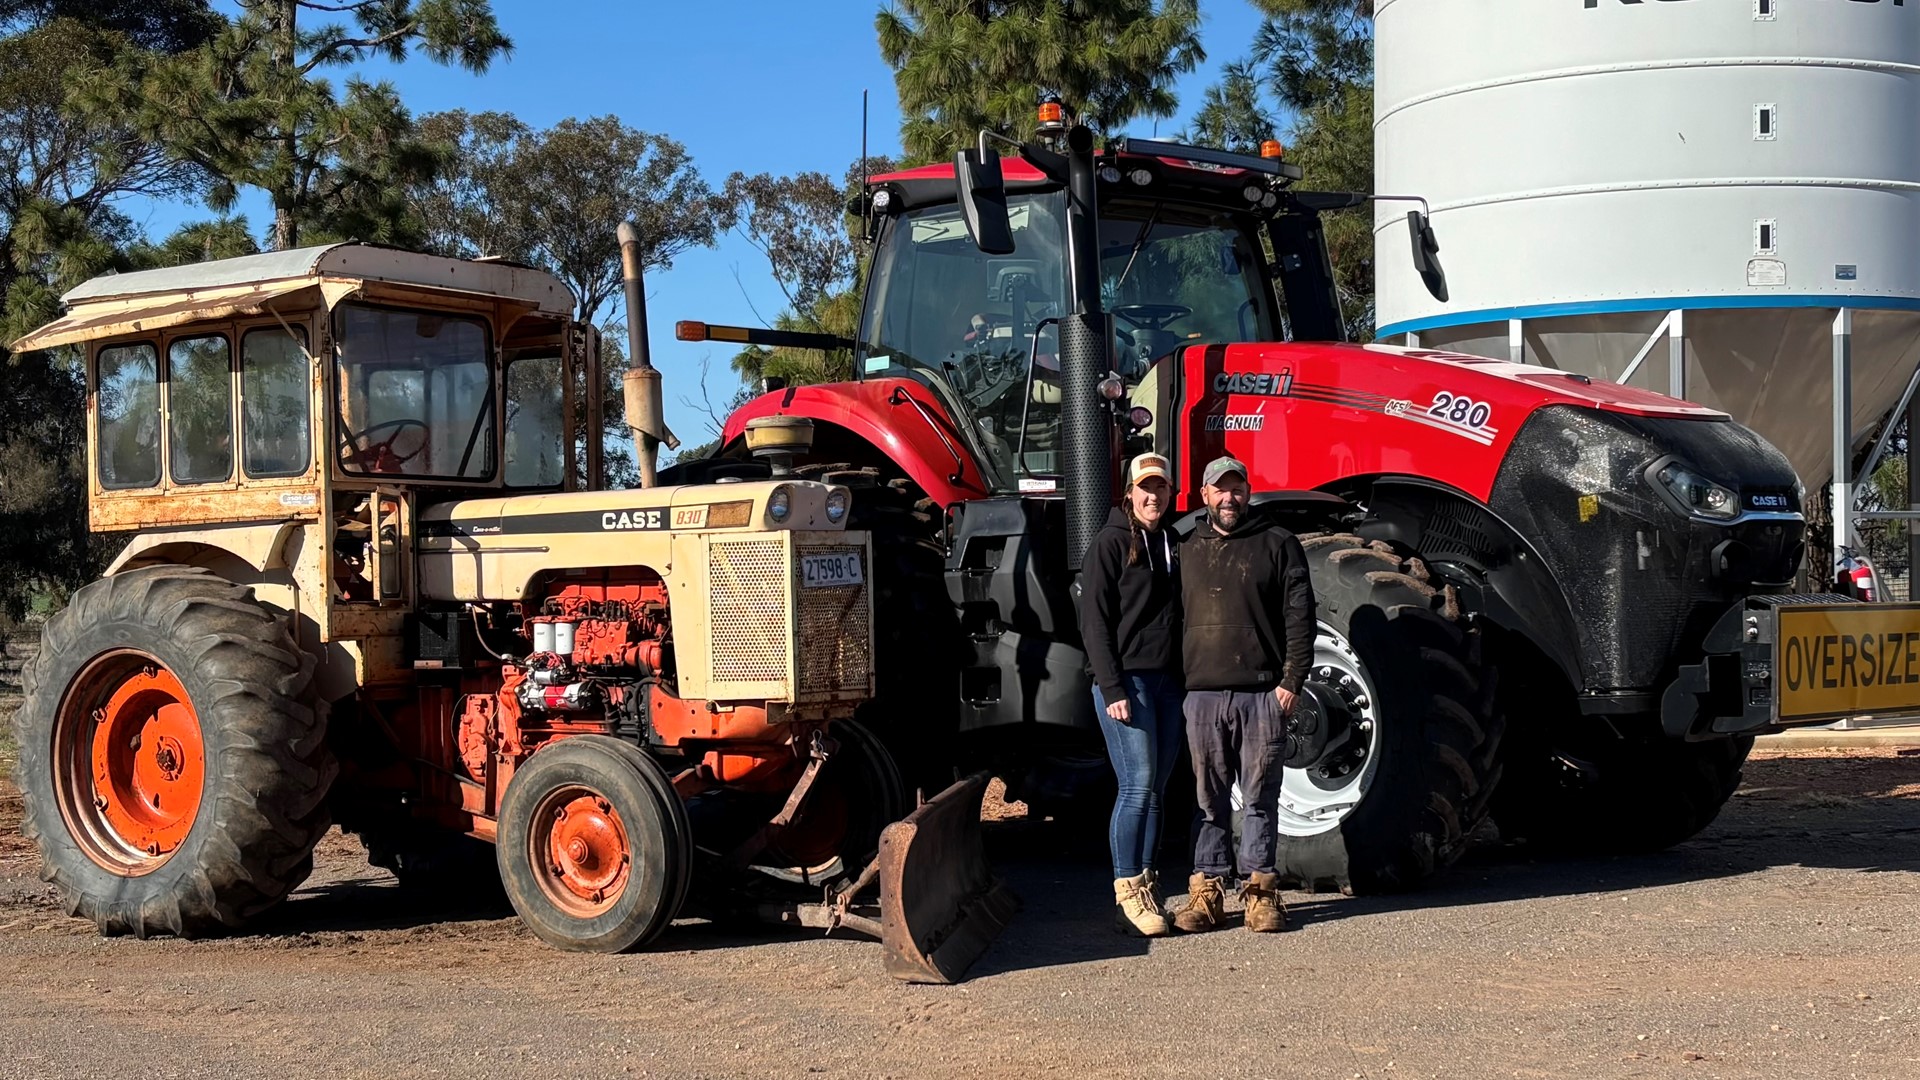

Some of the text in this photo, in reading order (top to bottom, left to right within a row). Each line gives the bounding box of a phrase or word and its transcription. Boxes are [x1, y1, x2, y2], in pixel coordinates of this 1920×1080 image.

[1213, 372, 1271, 394] CASE
[1430, 393, 1489, 428] 280
[1205, 414, 1265, 431] MAGNUM
[1752, 495, 1778, 506] CASE
[601, 511, 661, 530] CASE
[676, 510, 701, 525] 830
[1785, 632, 1920, 692] OVERSIZE
